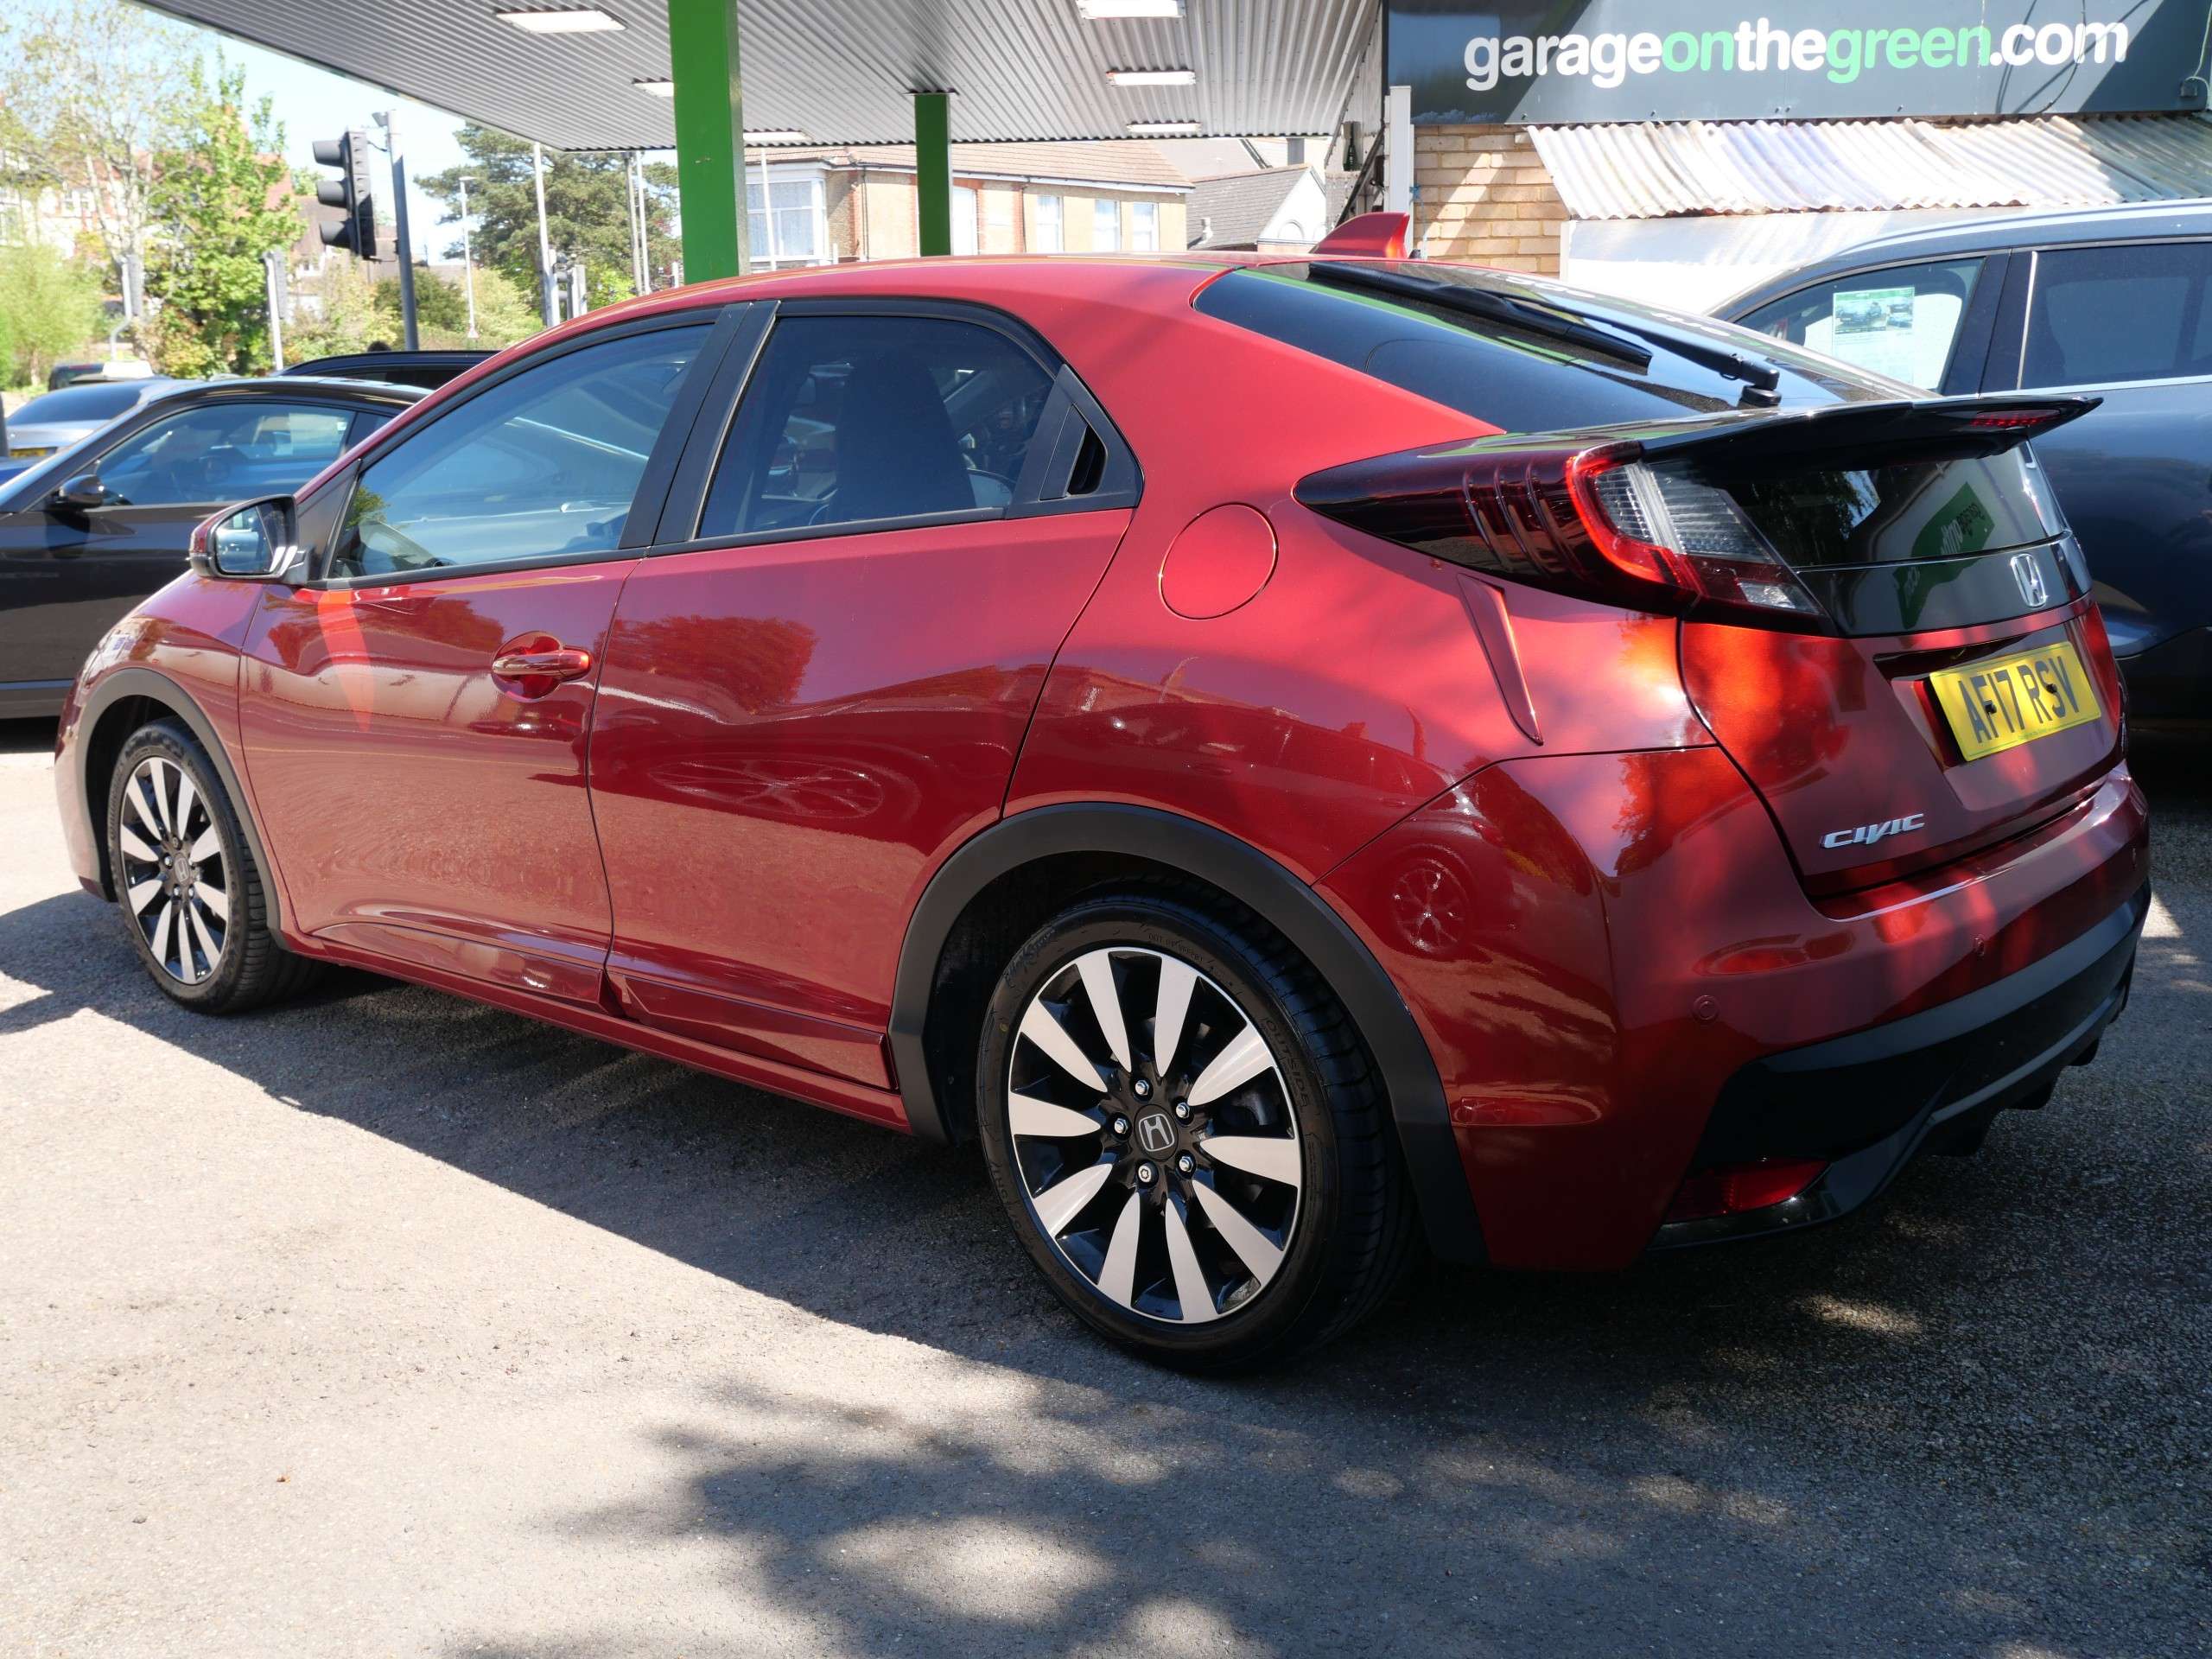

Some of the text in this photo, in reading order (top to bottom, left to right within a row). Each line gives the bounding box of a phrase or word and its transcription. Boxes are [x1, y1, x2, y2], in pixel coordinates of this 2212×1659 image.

[1464, 17, 2129, 90] garageonthegreen.com
[1957, 656, 2079, 743] AF17 RSV
[1821, 813, 1925, 849] CIVIC
